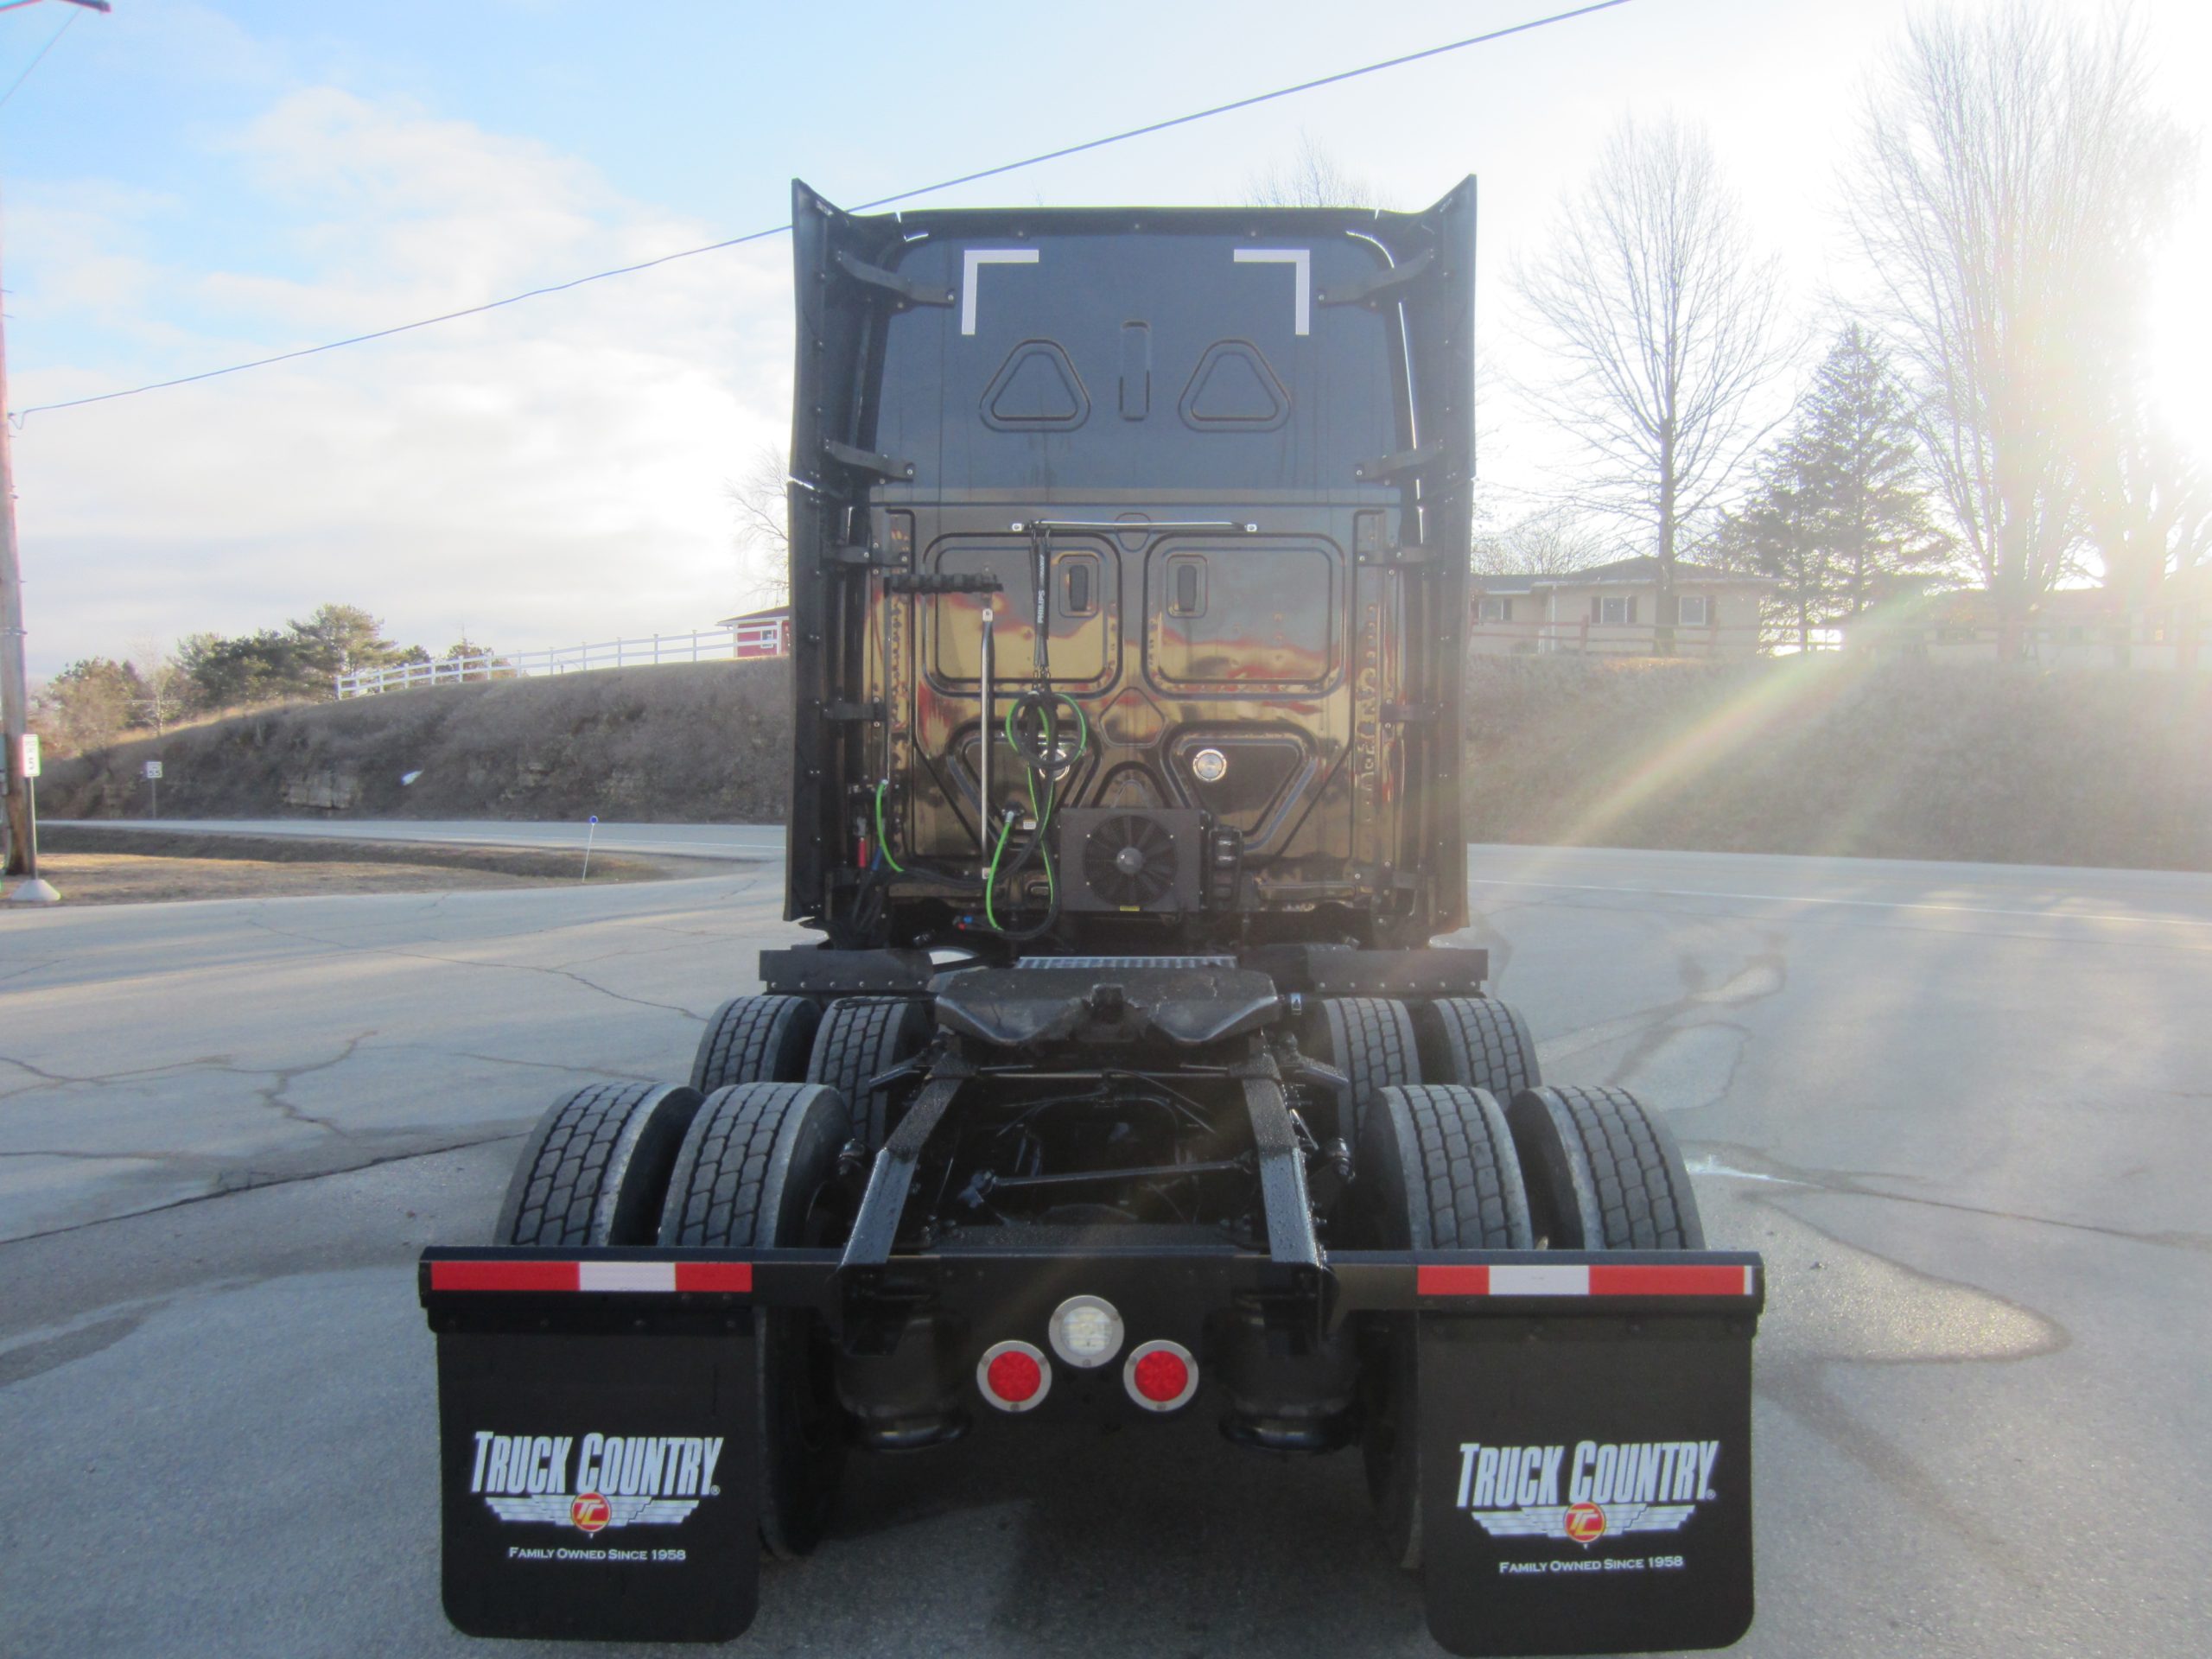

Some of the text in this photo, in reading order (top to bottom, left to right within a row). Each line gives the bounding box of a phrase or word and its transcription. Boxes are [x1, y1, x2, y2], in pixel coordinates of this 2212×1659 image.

[470, 1431, 724, 1496] TRUCK COUNTRY
[1457, 1440, 1719, 1508] TRUCK COUNTRY
[508, 1547, 687, 1561] FAMILY OWNED SINCE 1958
[1499, 1556, 1683, 1574] FAMILY OWNED SINCE 1958
